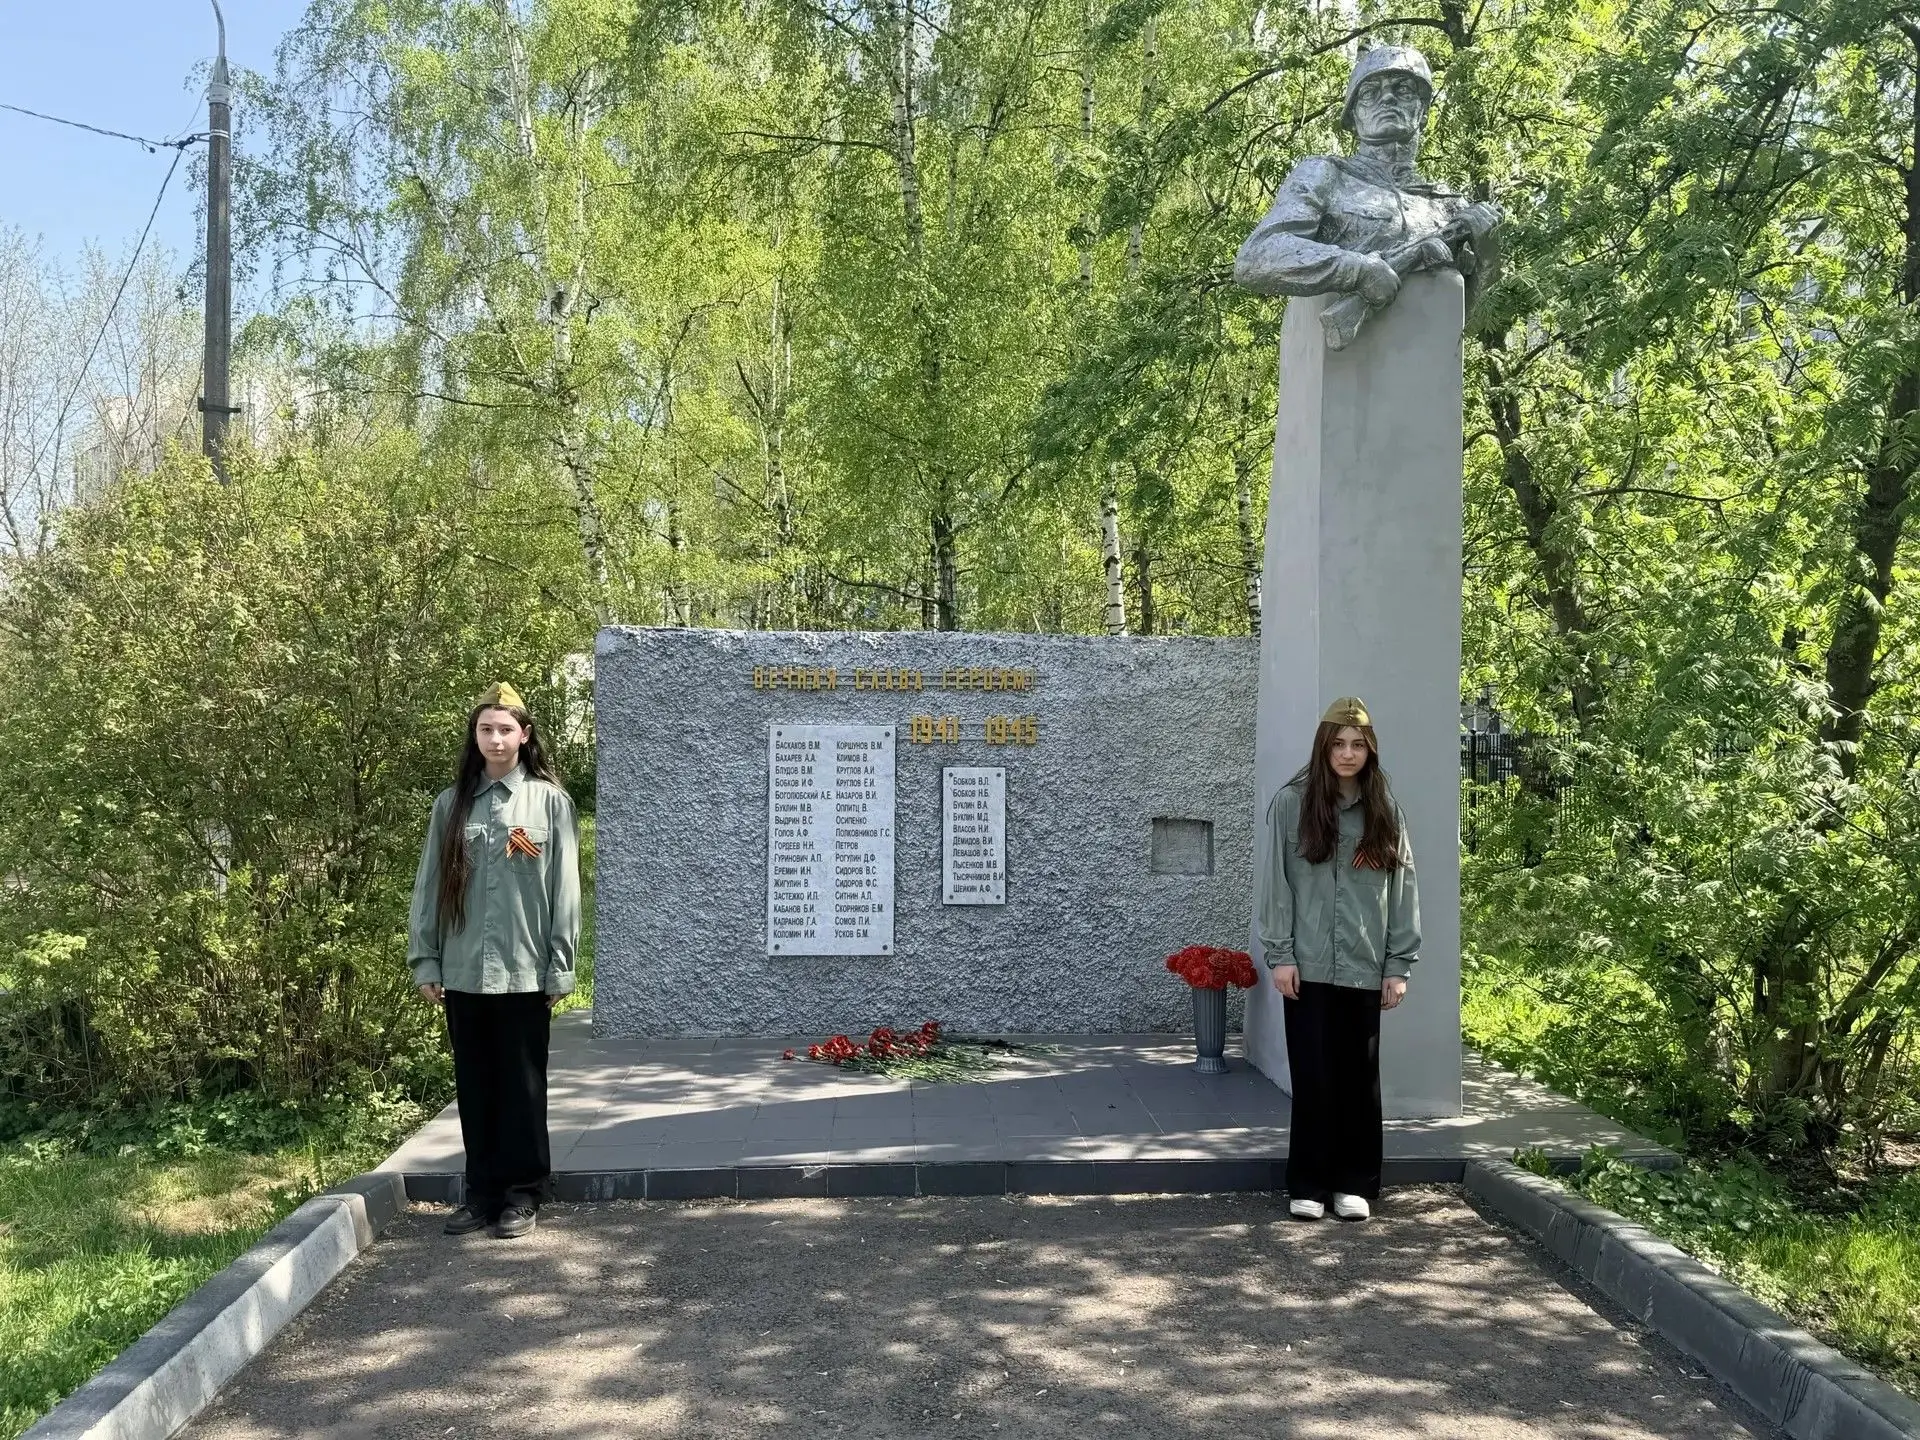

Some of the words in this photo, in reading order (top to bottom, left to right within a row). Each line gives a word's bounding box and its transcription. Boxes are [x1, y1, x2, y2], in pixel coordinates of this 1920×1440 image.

[753, 666, 837, 689] ВЕЧНАЯ
[855, 668, 923, 690] СЛАВА
[911, 716, 959, 744] 1941
[986, 716, 1037, 744] 1945
[776, 741, 806, 749] БАСКАКОВ
[837, 741, 868, 749] КОРШУНОВ
[776, 754, 802, 762] БАХАРЕВ
[836, 841, 858, 849] ПЕТРОВ
